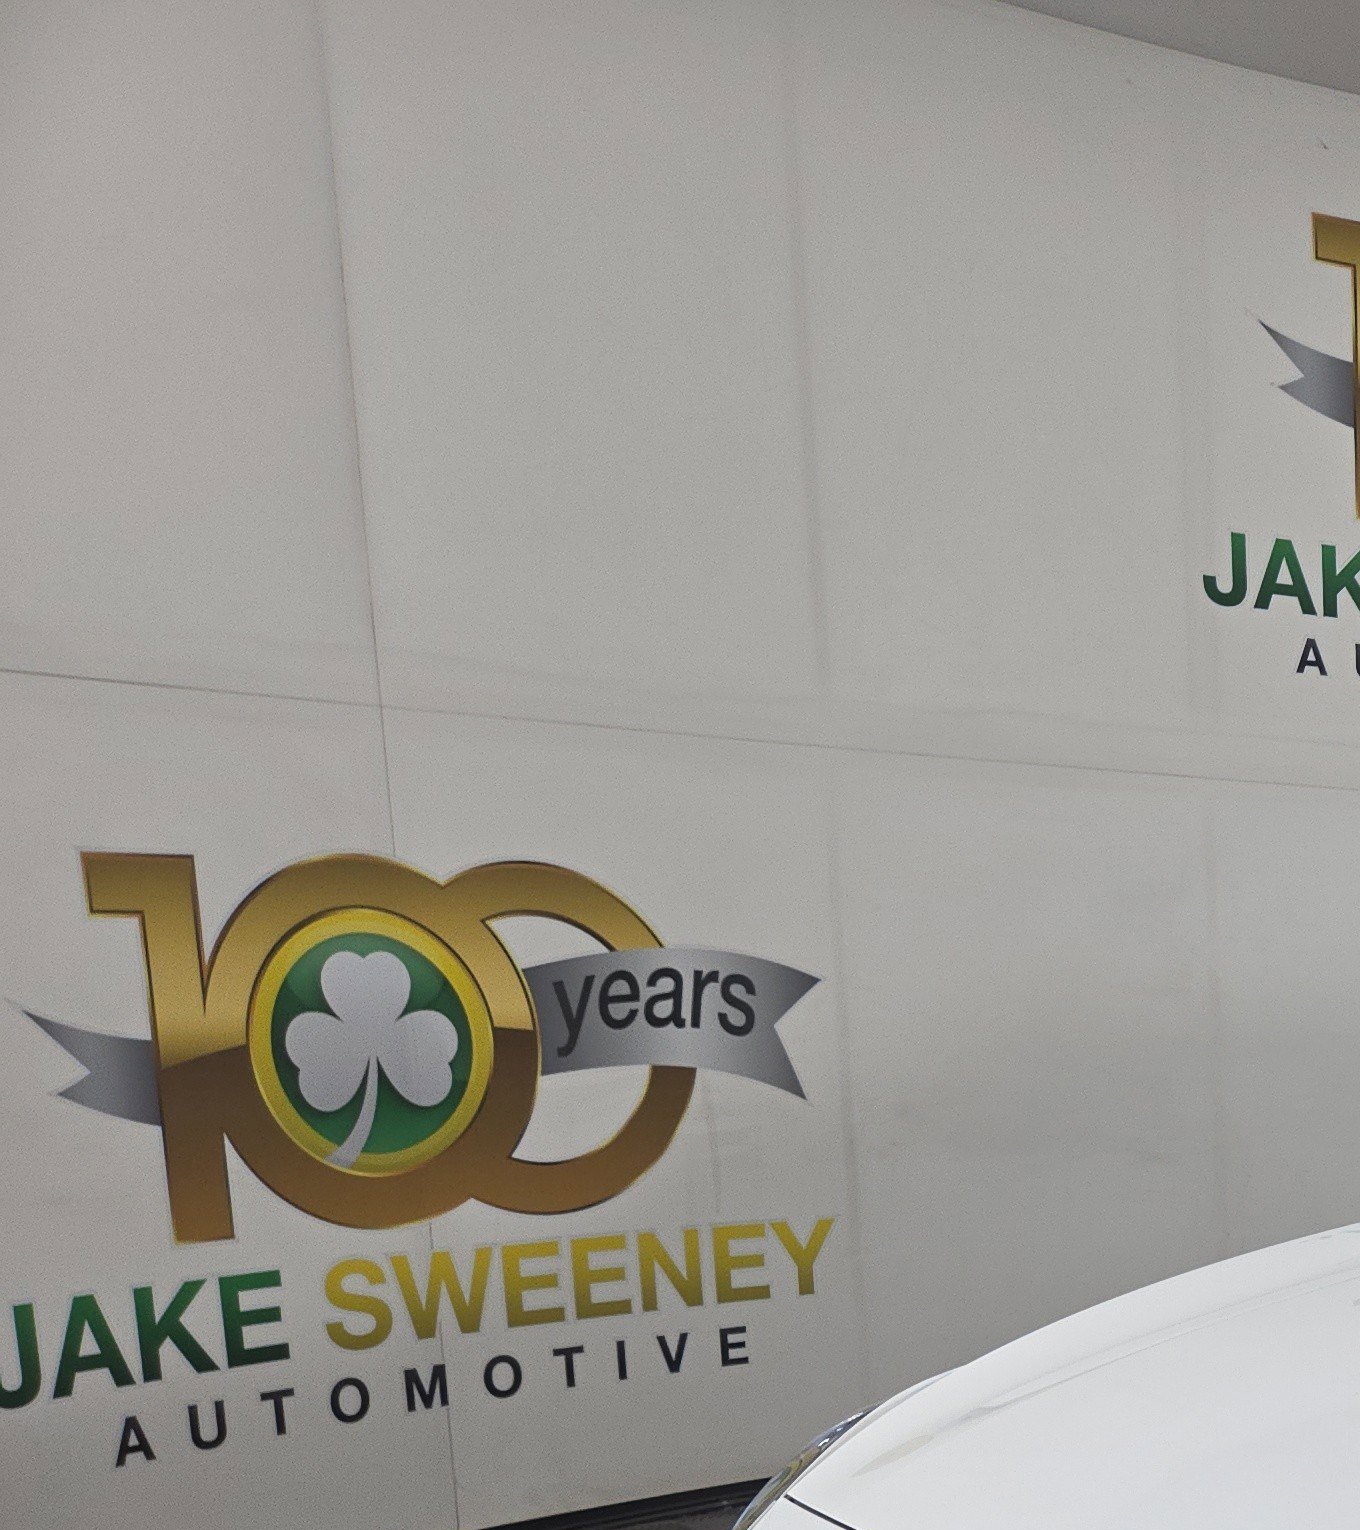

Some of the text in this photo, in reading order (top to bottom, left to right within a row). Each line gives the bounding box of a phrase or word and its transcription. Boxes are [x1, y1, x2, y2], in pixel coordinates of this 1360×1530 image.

[80, 850, 698, 1245] 100
[553, 965, 757, 1058] years
[0, 1216, 837, 1410] JAKE SWEENEY
[114, 1325, 750, 1468] AUTOMOTIVE
